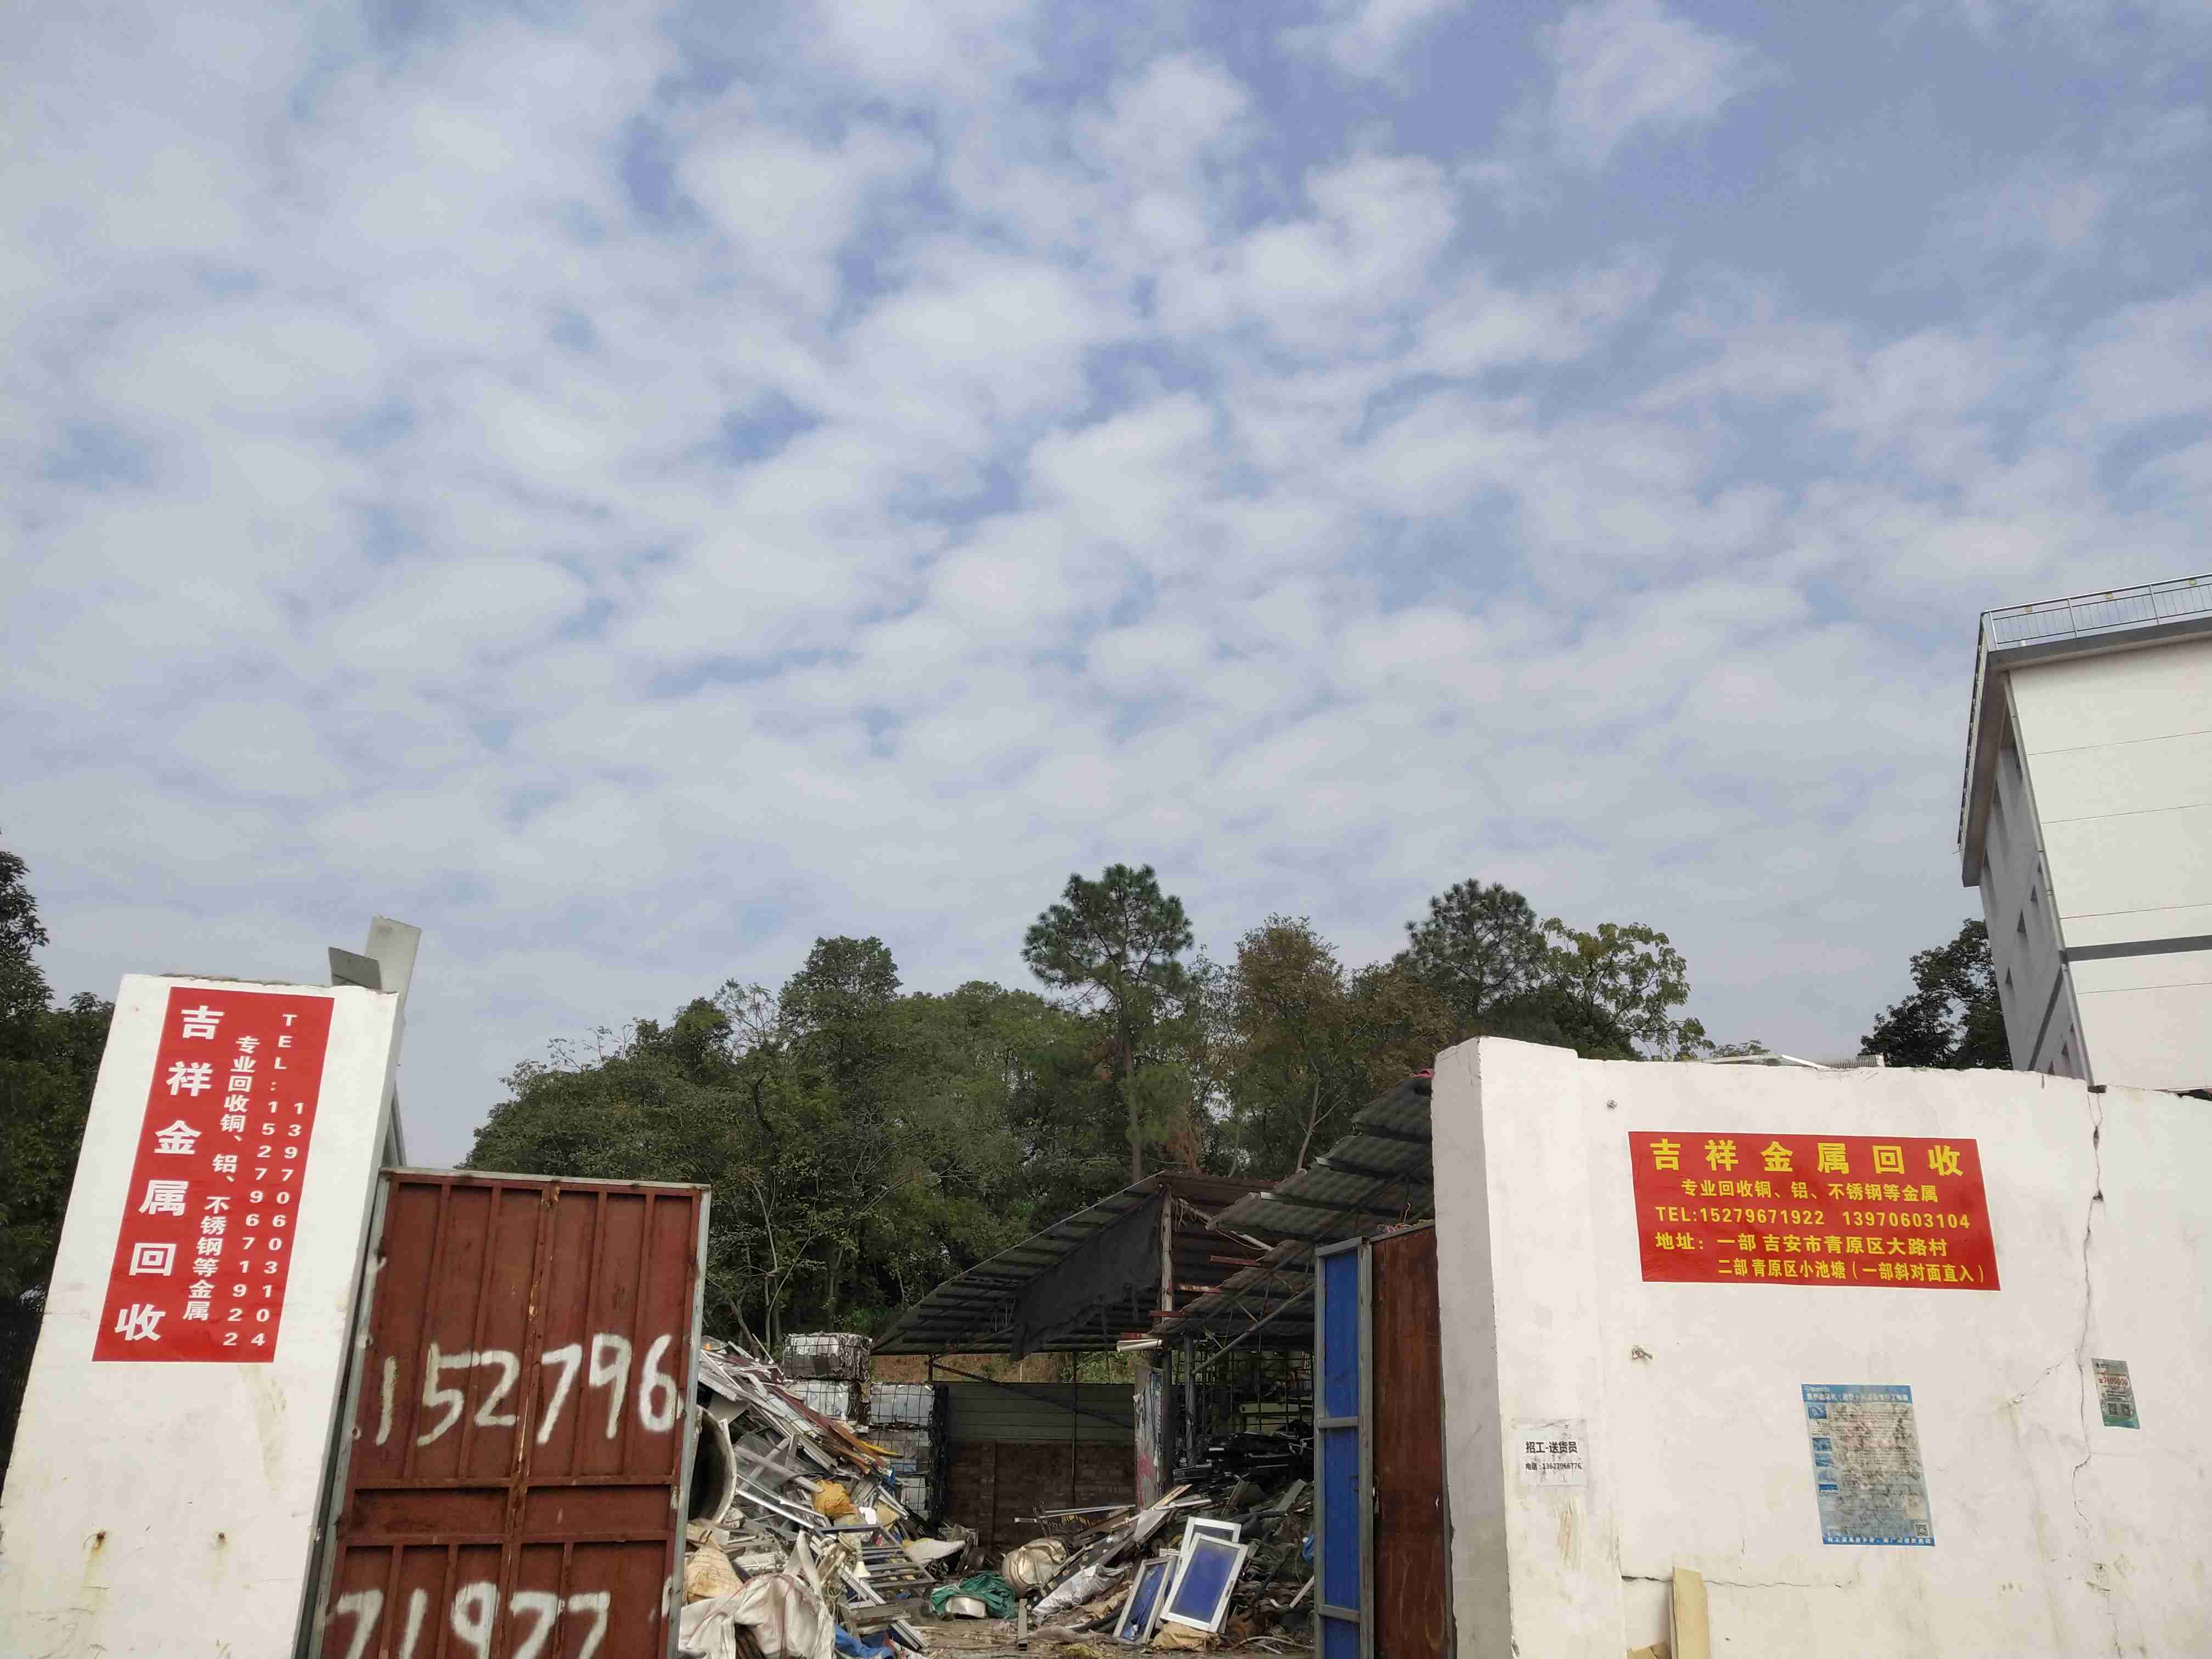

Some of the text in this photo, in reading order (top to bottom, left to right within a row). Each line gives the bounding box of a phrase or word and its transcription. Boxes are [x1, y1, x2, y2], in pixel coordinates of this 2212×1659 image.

[114, 1005, 224, 1341] 吉祥金属回收
[183, 1035, 260, 1321] 专业回收铜、铝、不锈钢等金属
[1649, 1138, 1963, 1177] 吉祥金属回收
[1681, 1180, 1939, 1203] 专业回收铜、铝、不锈钢等金属
[251, 1102, 304, 1347] 13970603104
[1655, 1206, 1970, 1229] TEL:15279671922 13970603104
[375, 1333, 676, 1447] 152796
[1525, 1441, 1578, 1453] 招工-送货员
